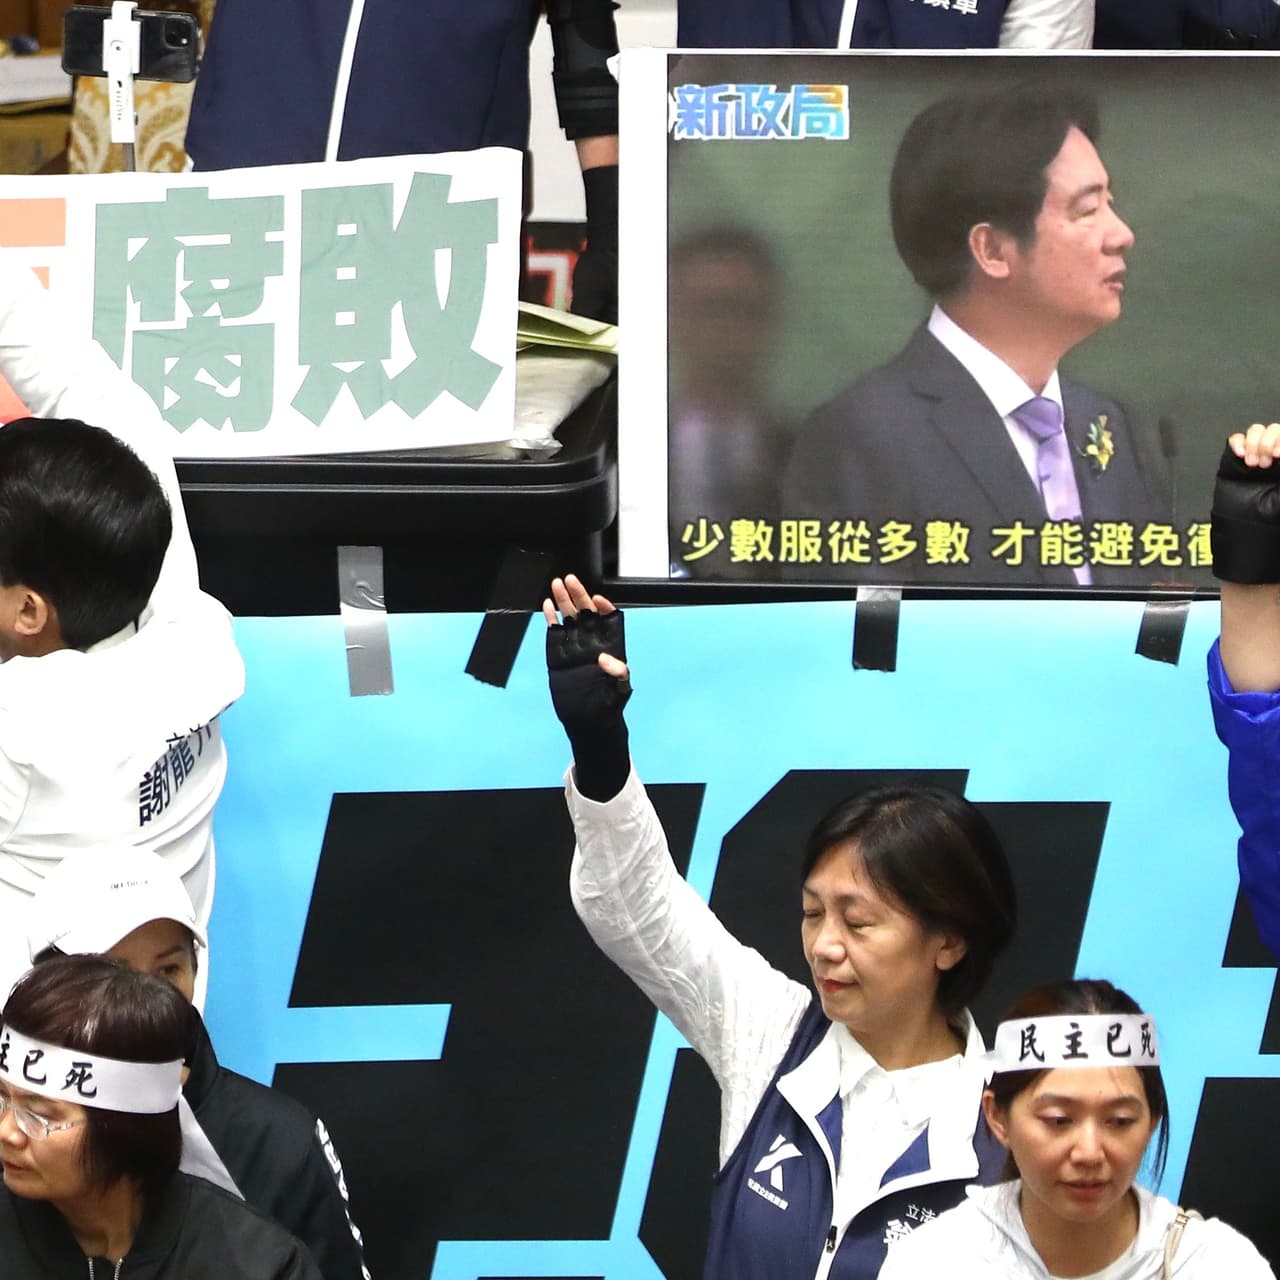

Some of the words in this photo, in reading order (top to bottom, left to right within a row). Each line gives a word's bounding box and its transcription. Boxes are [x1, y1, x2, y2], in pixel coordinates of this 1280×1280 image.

[672, 84, 850, 139] 新政局
[681, 518, 970, 564] 少數服從多數
